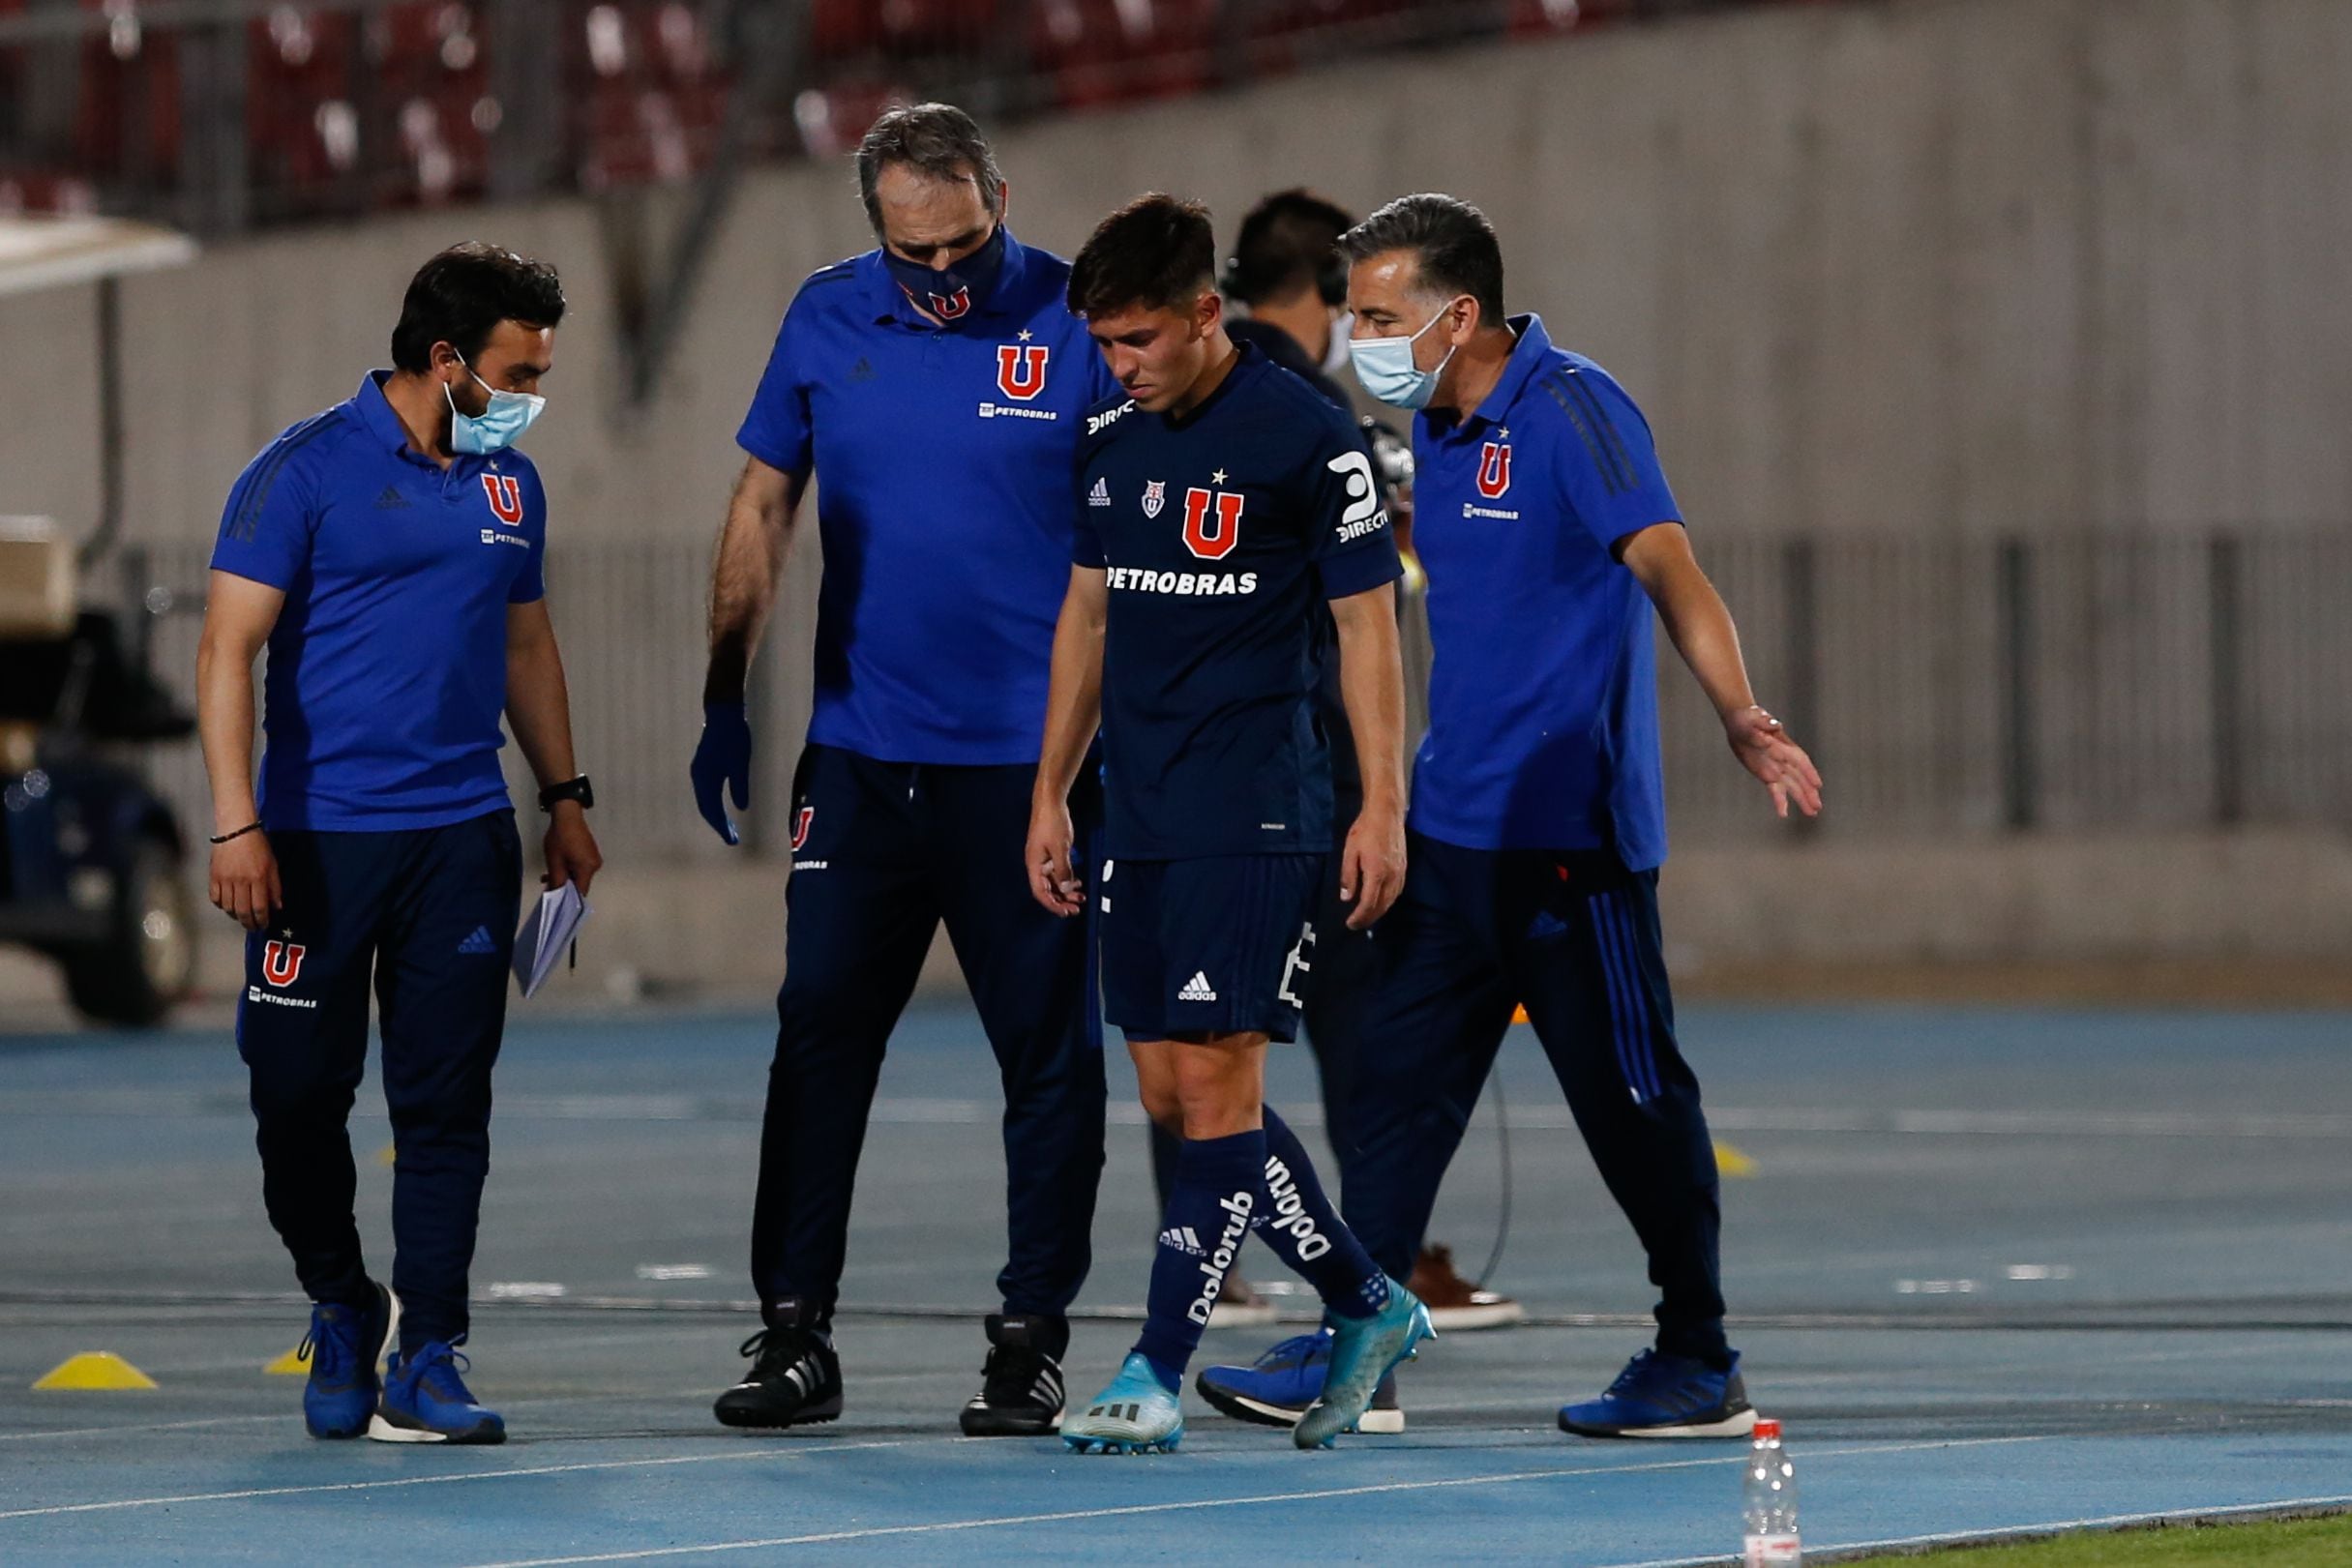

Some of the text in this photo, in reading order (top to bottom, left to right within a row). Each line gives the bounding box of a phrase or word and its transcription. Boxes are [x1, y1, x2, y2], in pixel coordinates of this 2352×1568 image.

[929, 285, 971, 319] U
[997, 345, 1050, 400] U
[996, 407, 1057, 421] PETROBRAS
[1475, 441, 1512, 500] U
[480, 473, 523, 526] U
[494, 533, 531, 548] PETROB
[1182, 488, 1245, 561] U
[1106, 567, 1258, 596] PETROBRAS
[263, 940, 306, 988] U
[260, 992, 317, 1008] PETROBRAS
[1177, 991, 1218, 1002] adidas
[1158, 1234, 1208, 1257] adidas
[1186, 1191, 1254, 1326] Dolorub
